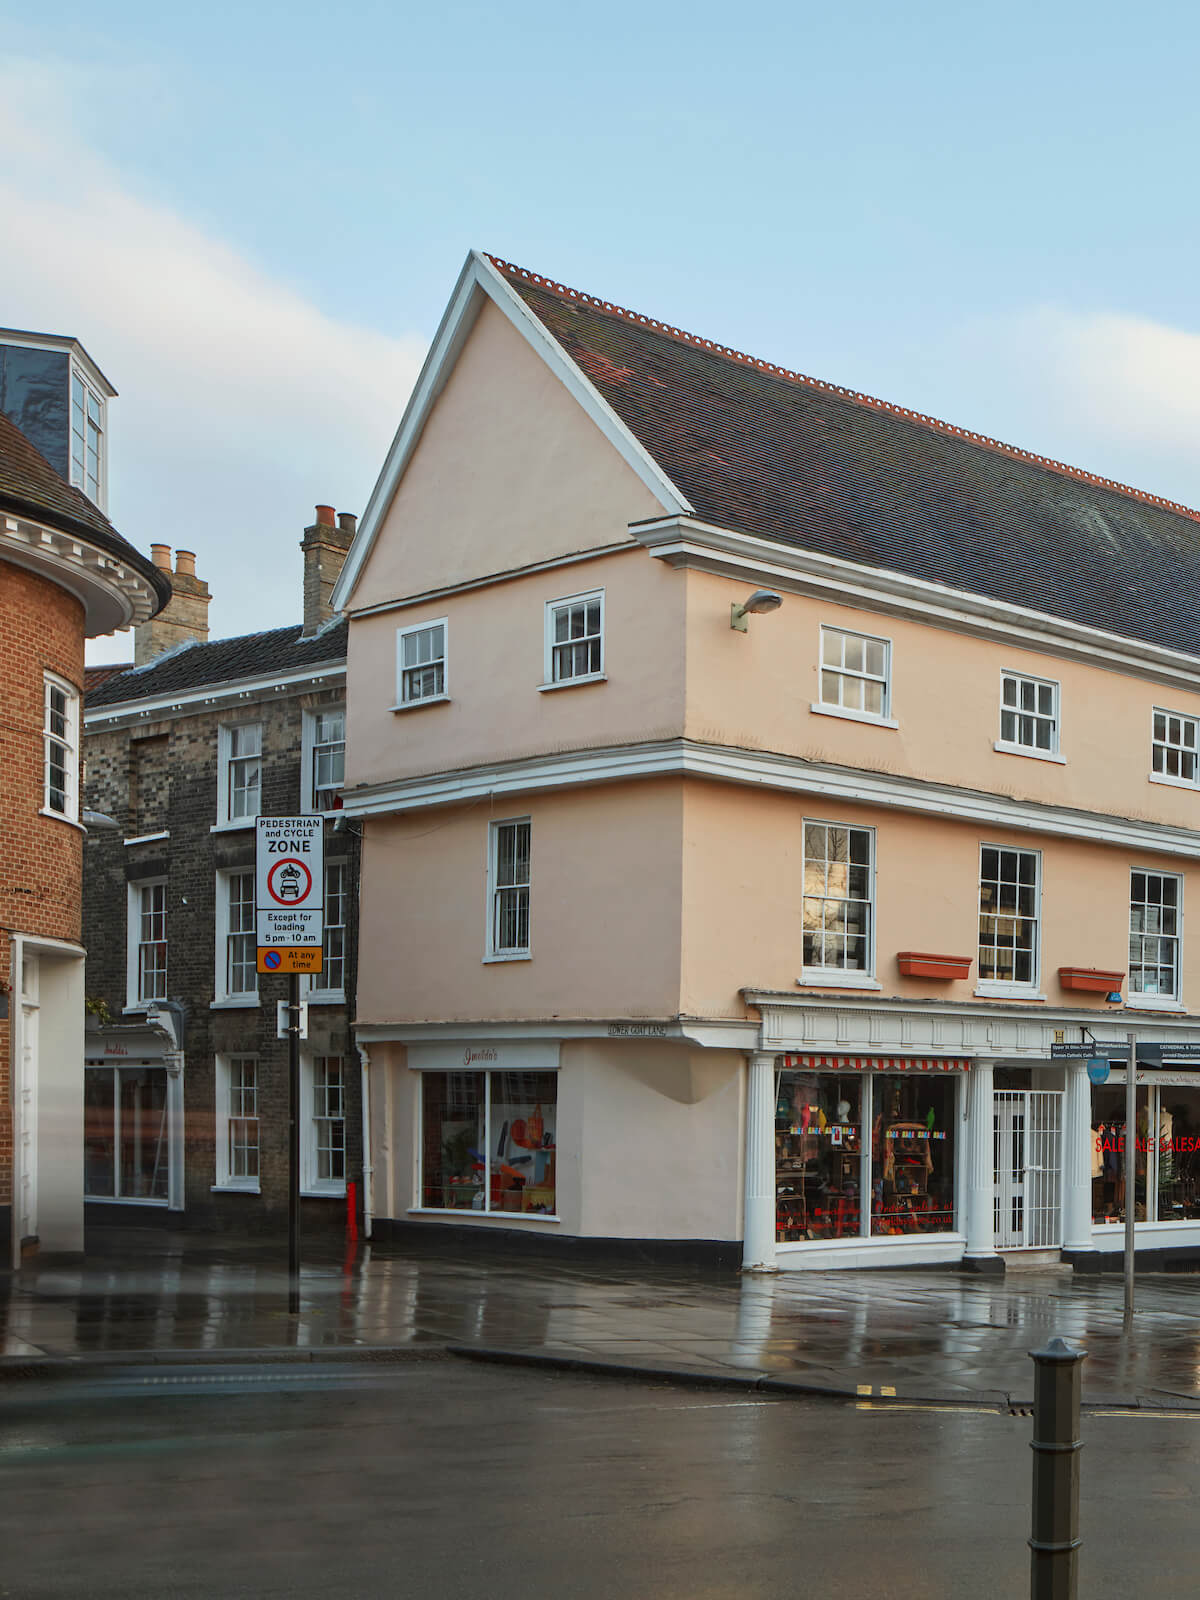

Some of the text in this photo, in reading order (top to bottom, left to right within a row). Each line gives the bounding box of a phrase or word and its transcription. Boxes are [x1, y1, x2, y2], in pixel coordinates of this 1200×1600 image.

[260, 819, 320, 828] PEDESTRIAN
[283, 829, 314, 837] CYCLE
[268, 840, 311, 853] ZONE
[268, 913, 312, 923] Except for
[274, 922, 305, 931] loading
[288, 951, 316, 961] At any
[292, 960, 311, 969] time
[1133, 1136, 1155, 1153] ALE
